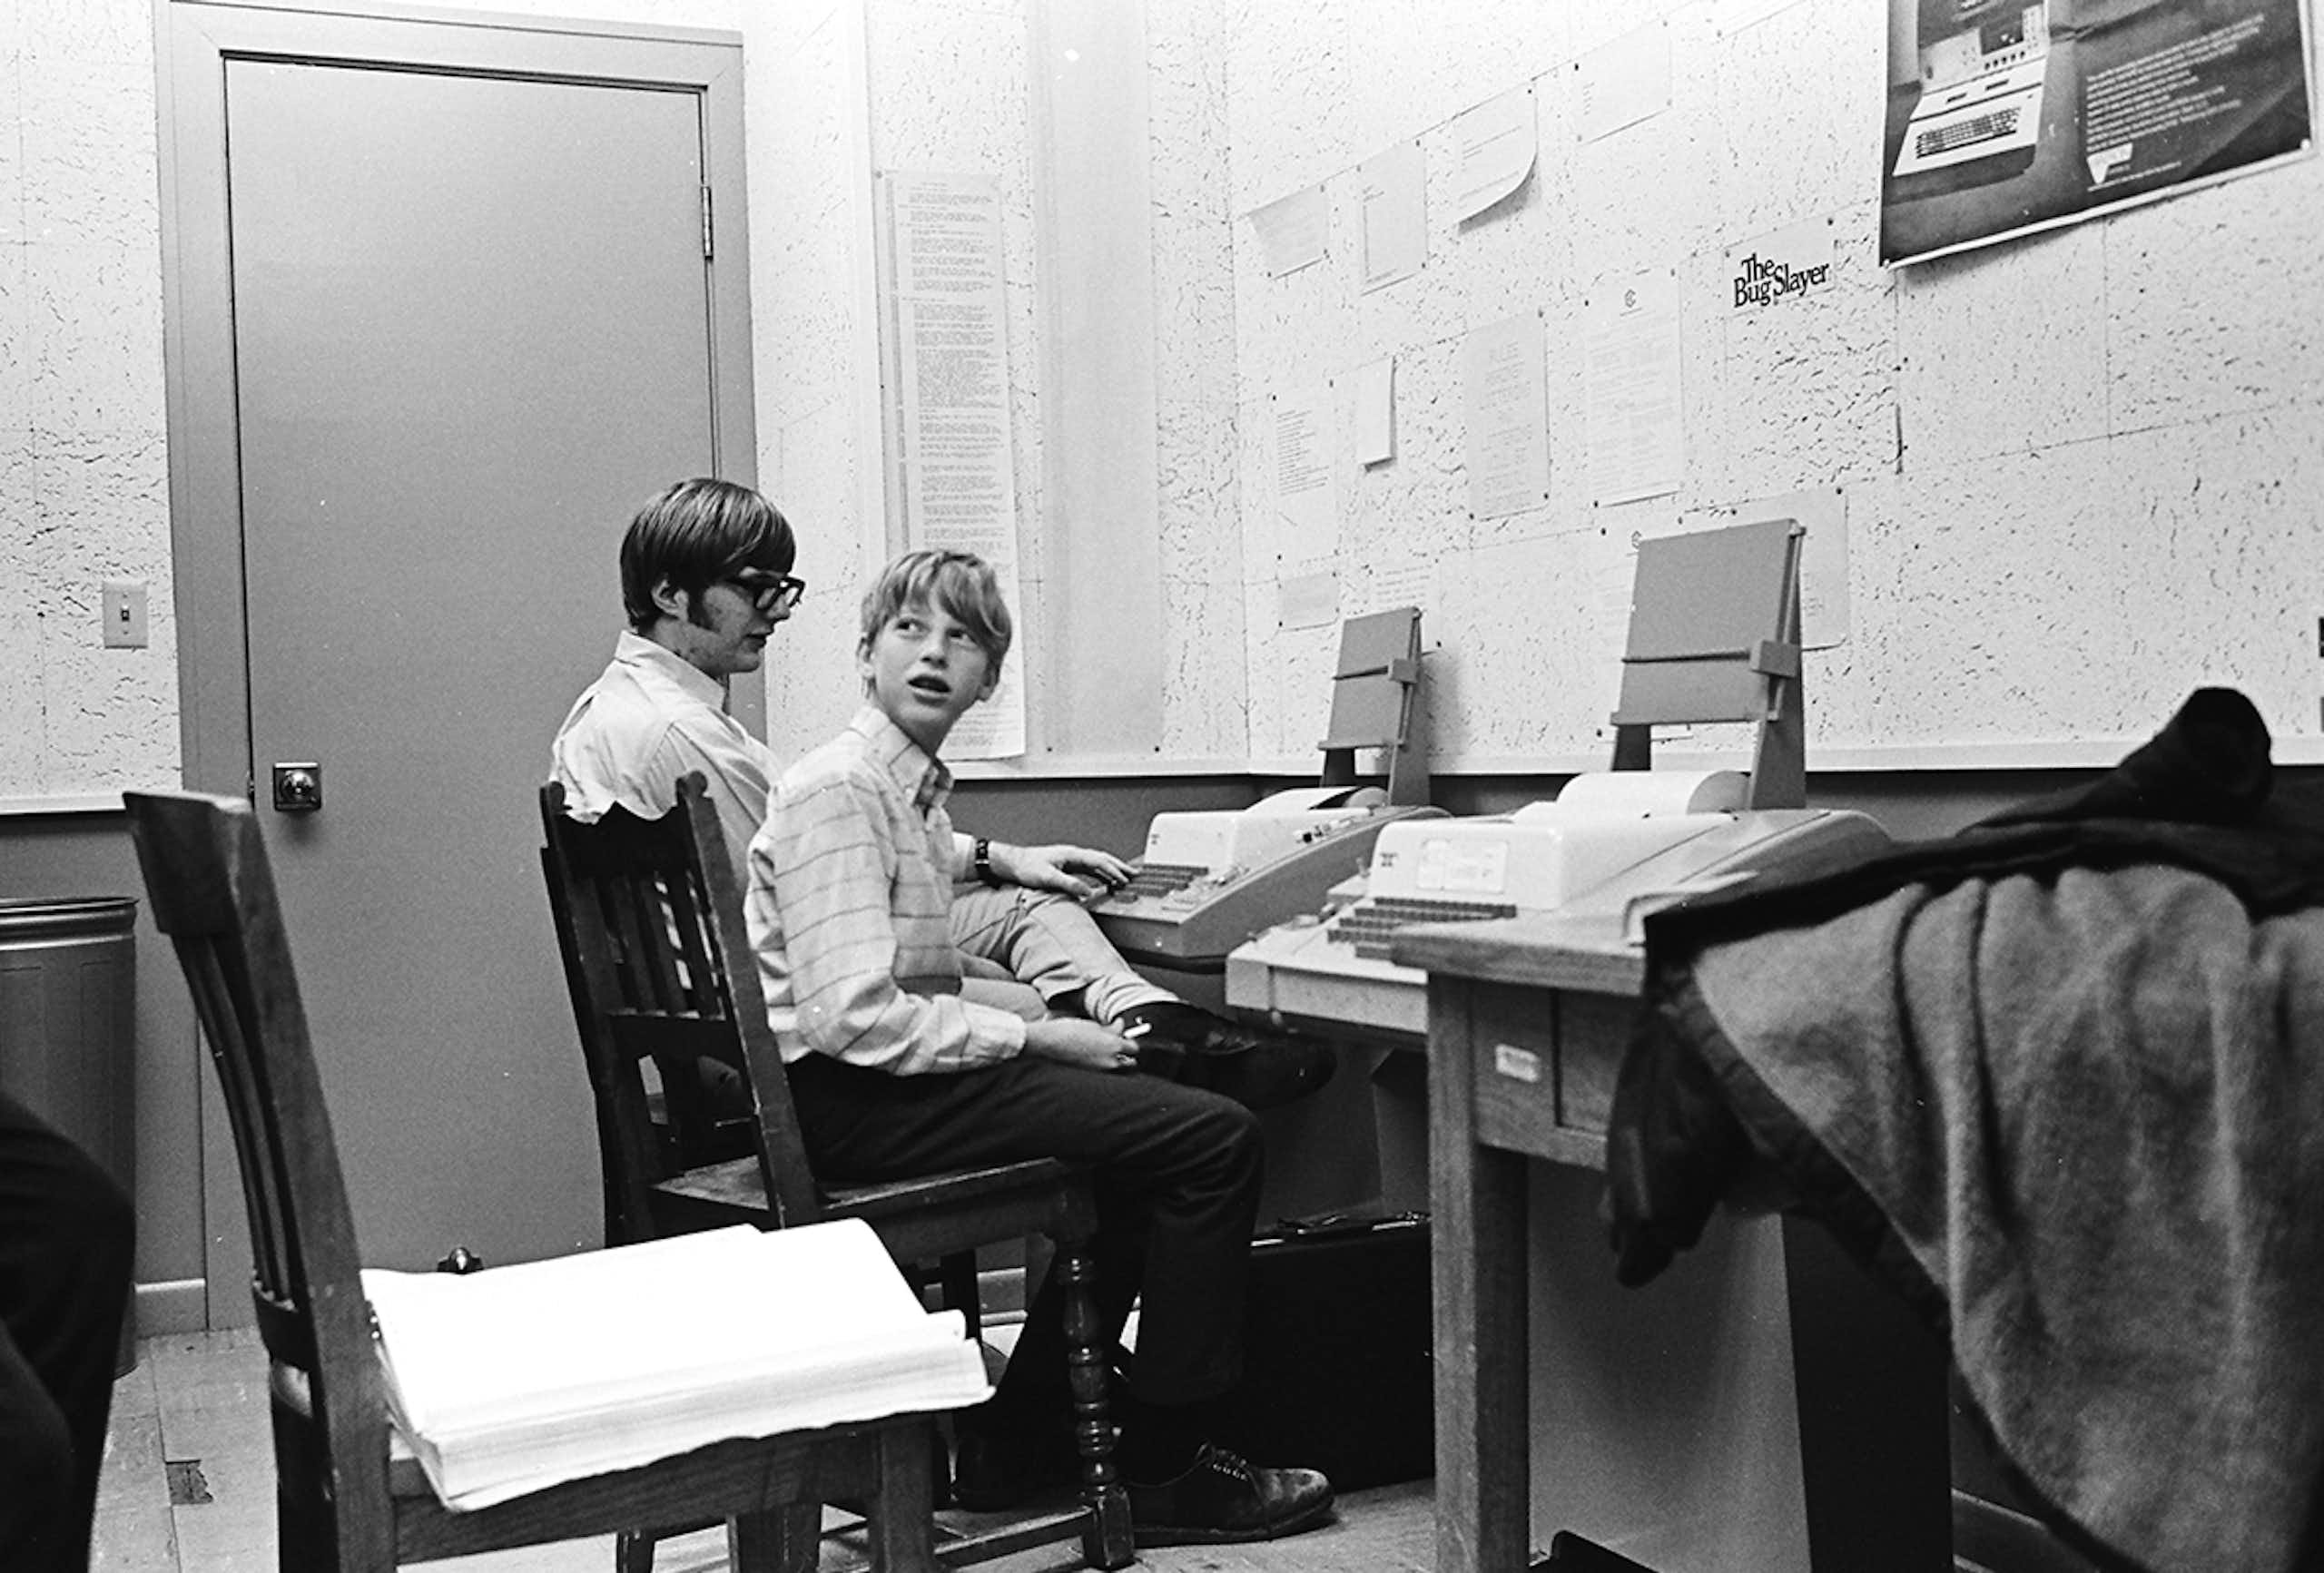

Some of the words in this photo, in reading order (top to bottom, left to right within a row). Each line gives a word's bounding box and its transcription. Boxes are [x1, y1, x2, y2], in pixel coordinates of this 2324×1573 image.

[1734, 277, 1772, 308] Bug
[1773, 263, 1829, 296] Slayer
[1741, 252, 1774, 282] The
